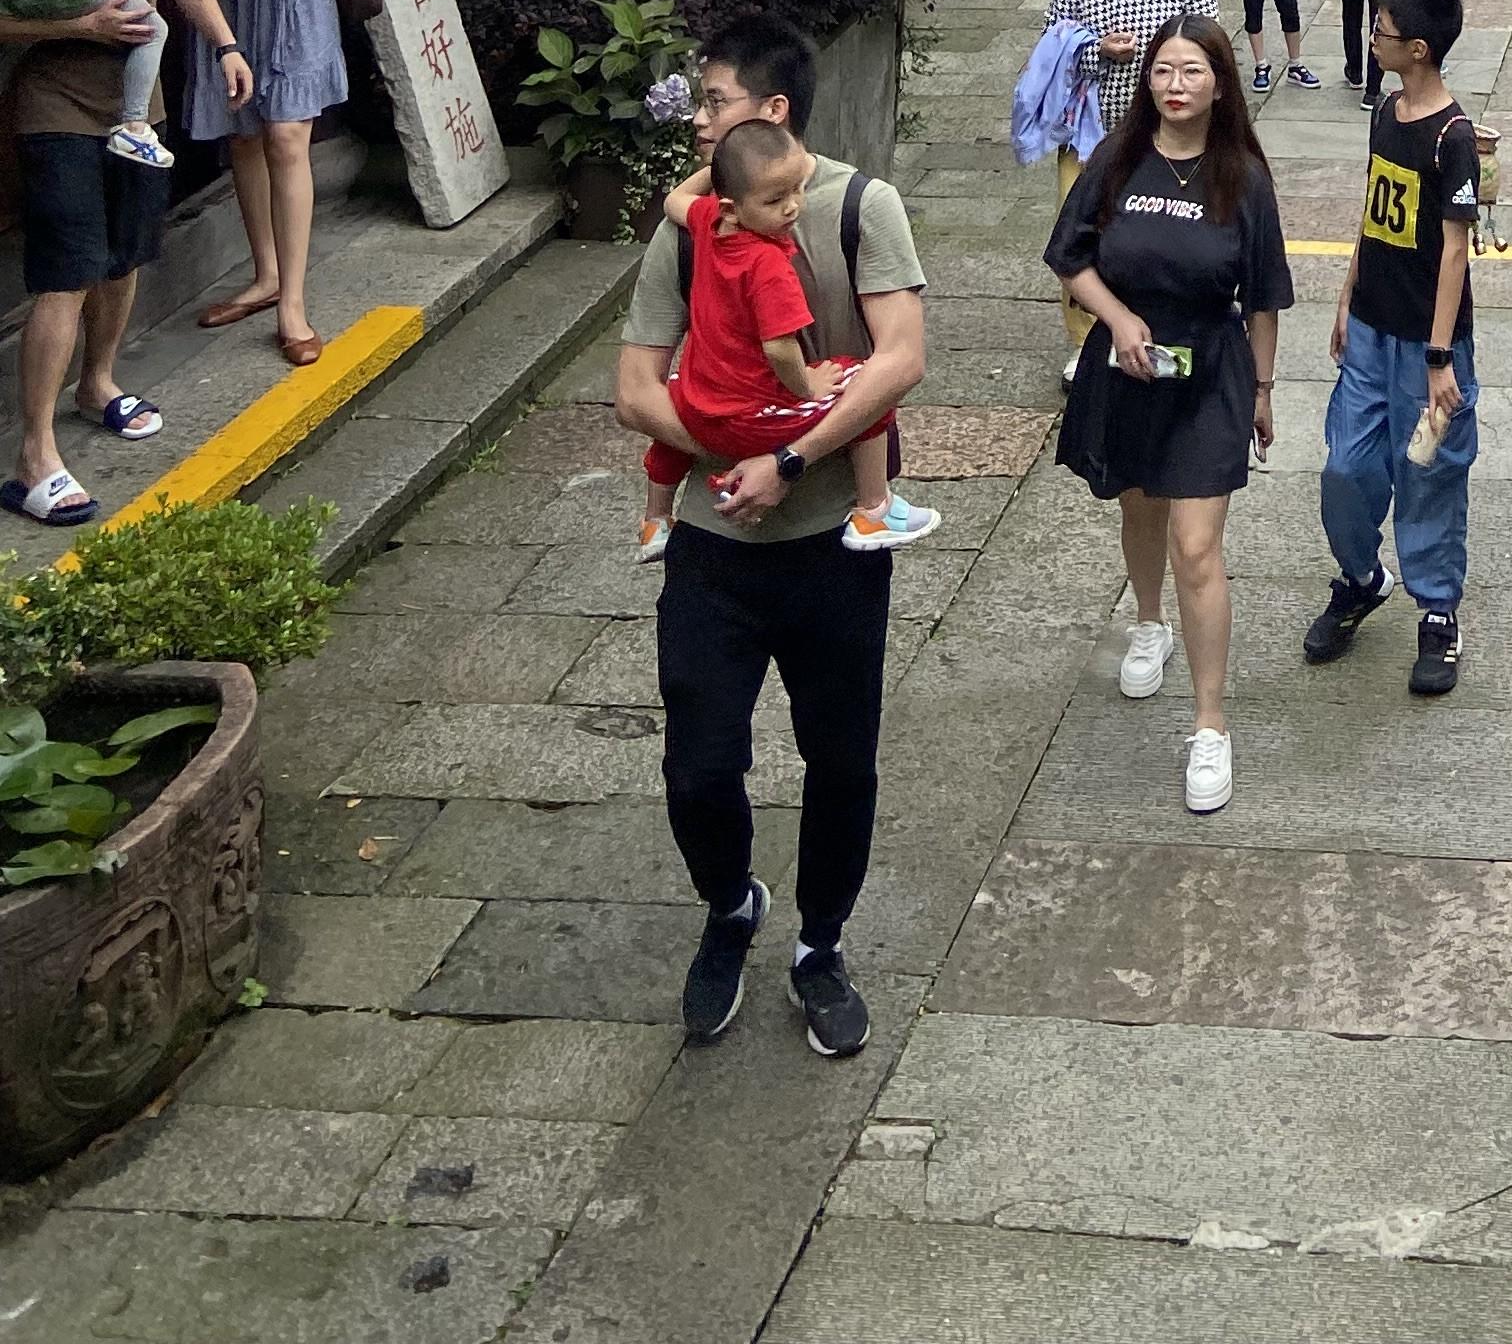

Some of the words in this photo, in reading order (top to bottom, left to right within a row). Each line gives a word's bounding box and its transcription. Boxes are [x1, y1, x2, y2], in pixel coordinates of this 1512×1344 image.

[1125, 194, 1165, 213] GOOD
[1165, 198, 1204, 221] VIBES
[1370, 174, 1407, 234] 03
